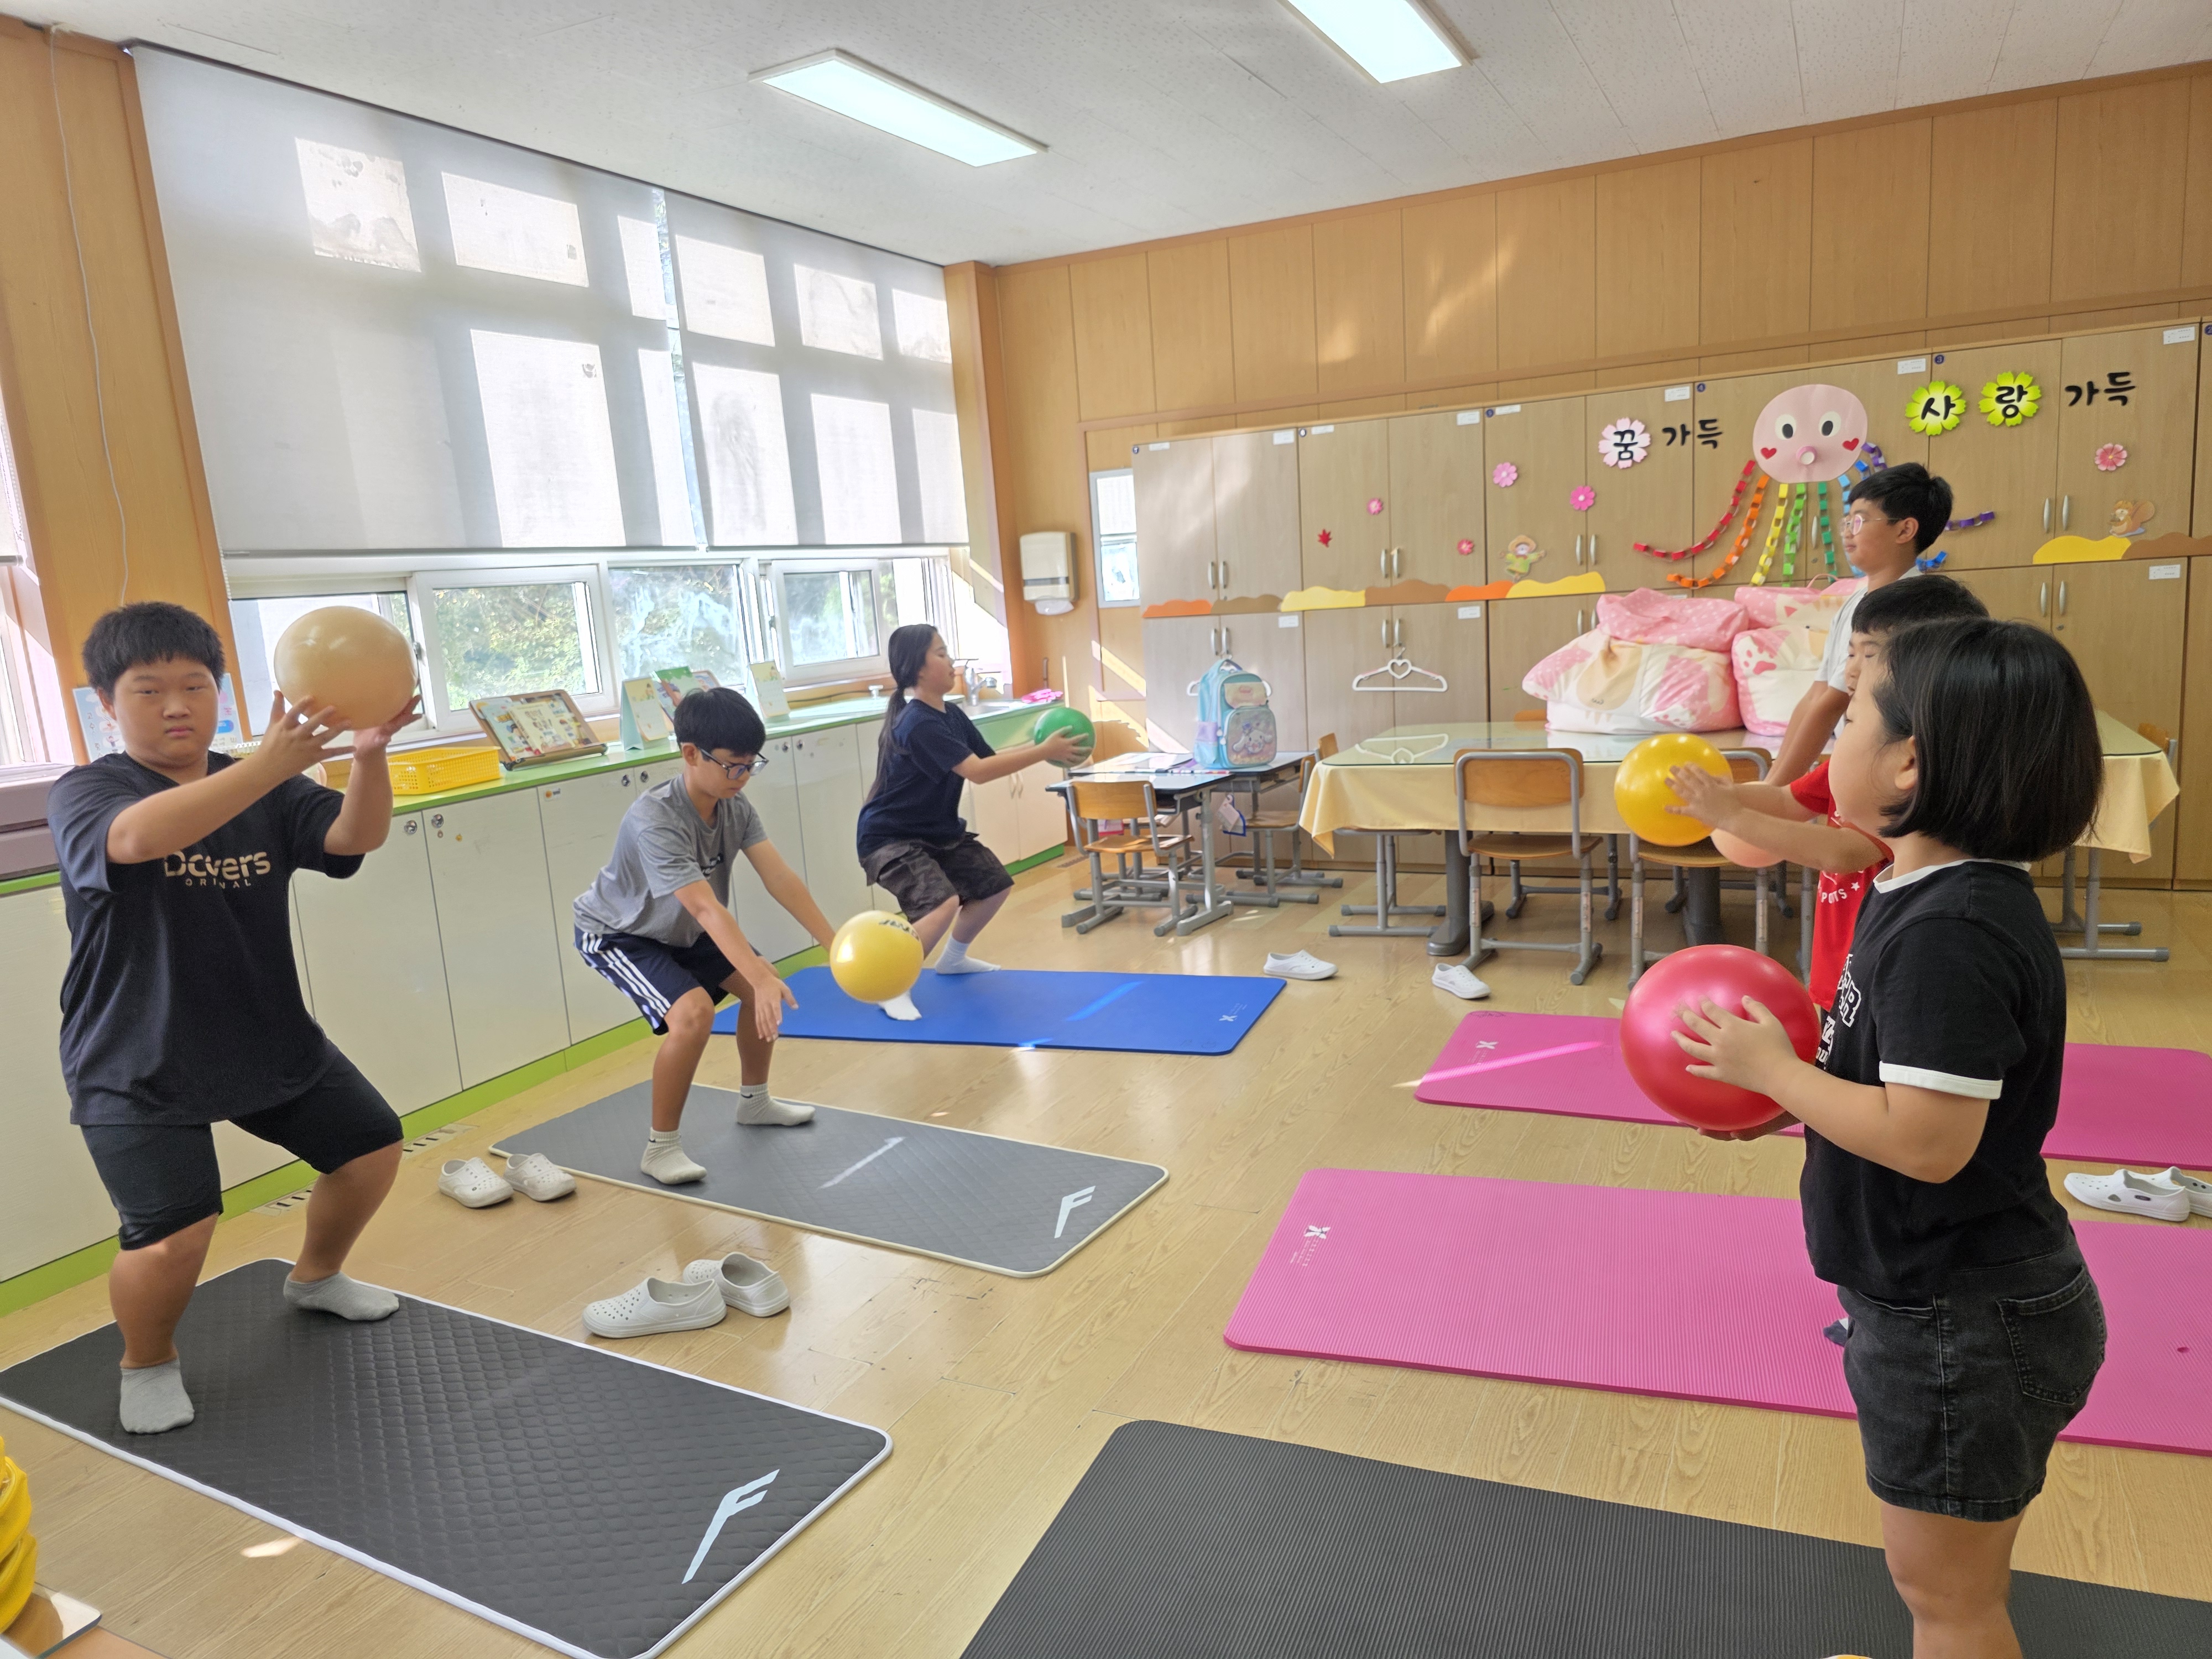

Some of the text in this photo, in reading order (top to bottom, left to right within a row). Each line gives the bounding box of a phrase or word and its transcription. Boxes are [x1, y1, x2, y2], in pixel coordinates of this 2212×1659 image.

[2064, 372, 2136, 406] 가득
[1613, 419, 1723, 461] 꿈 가득
